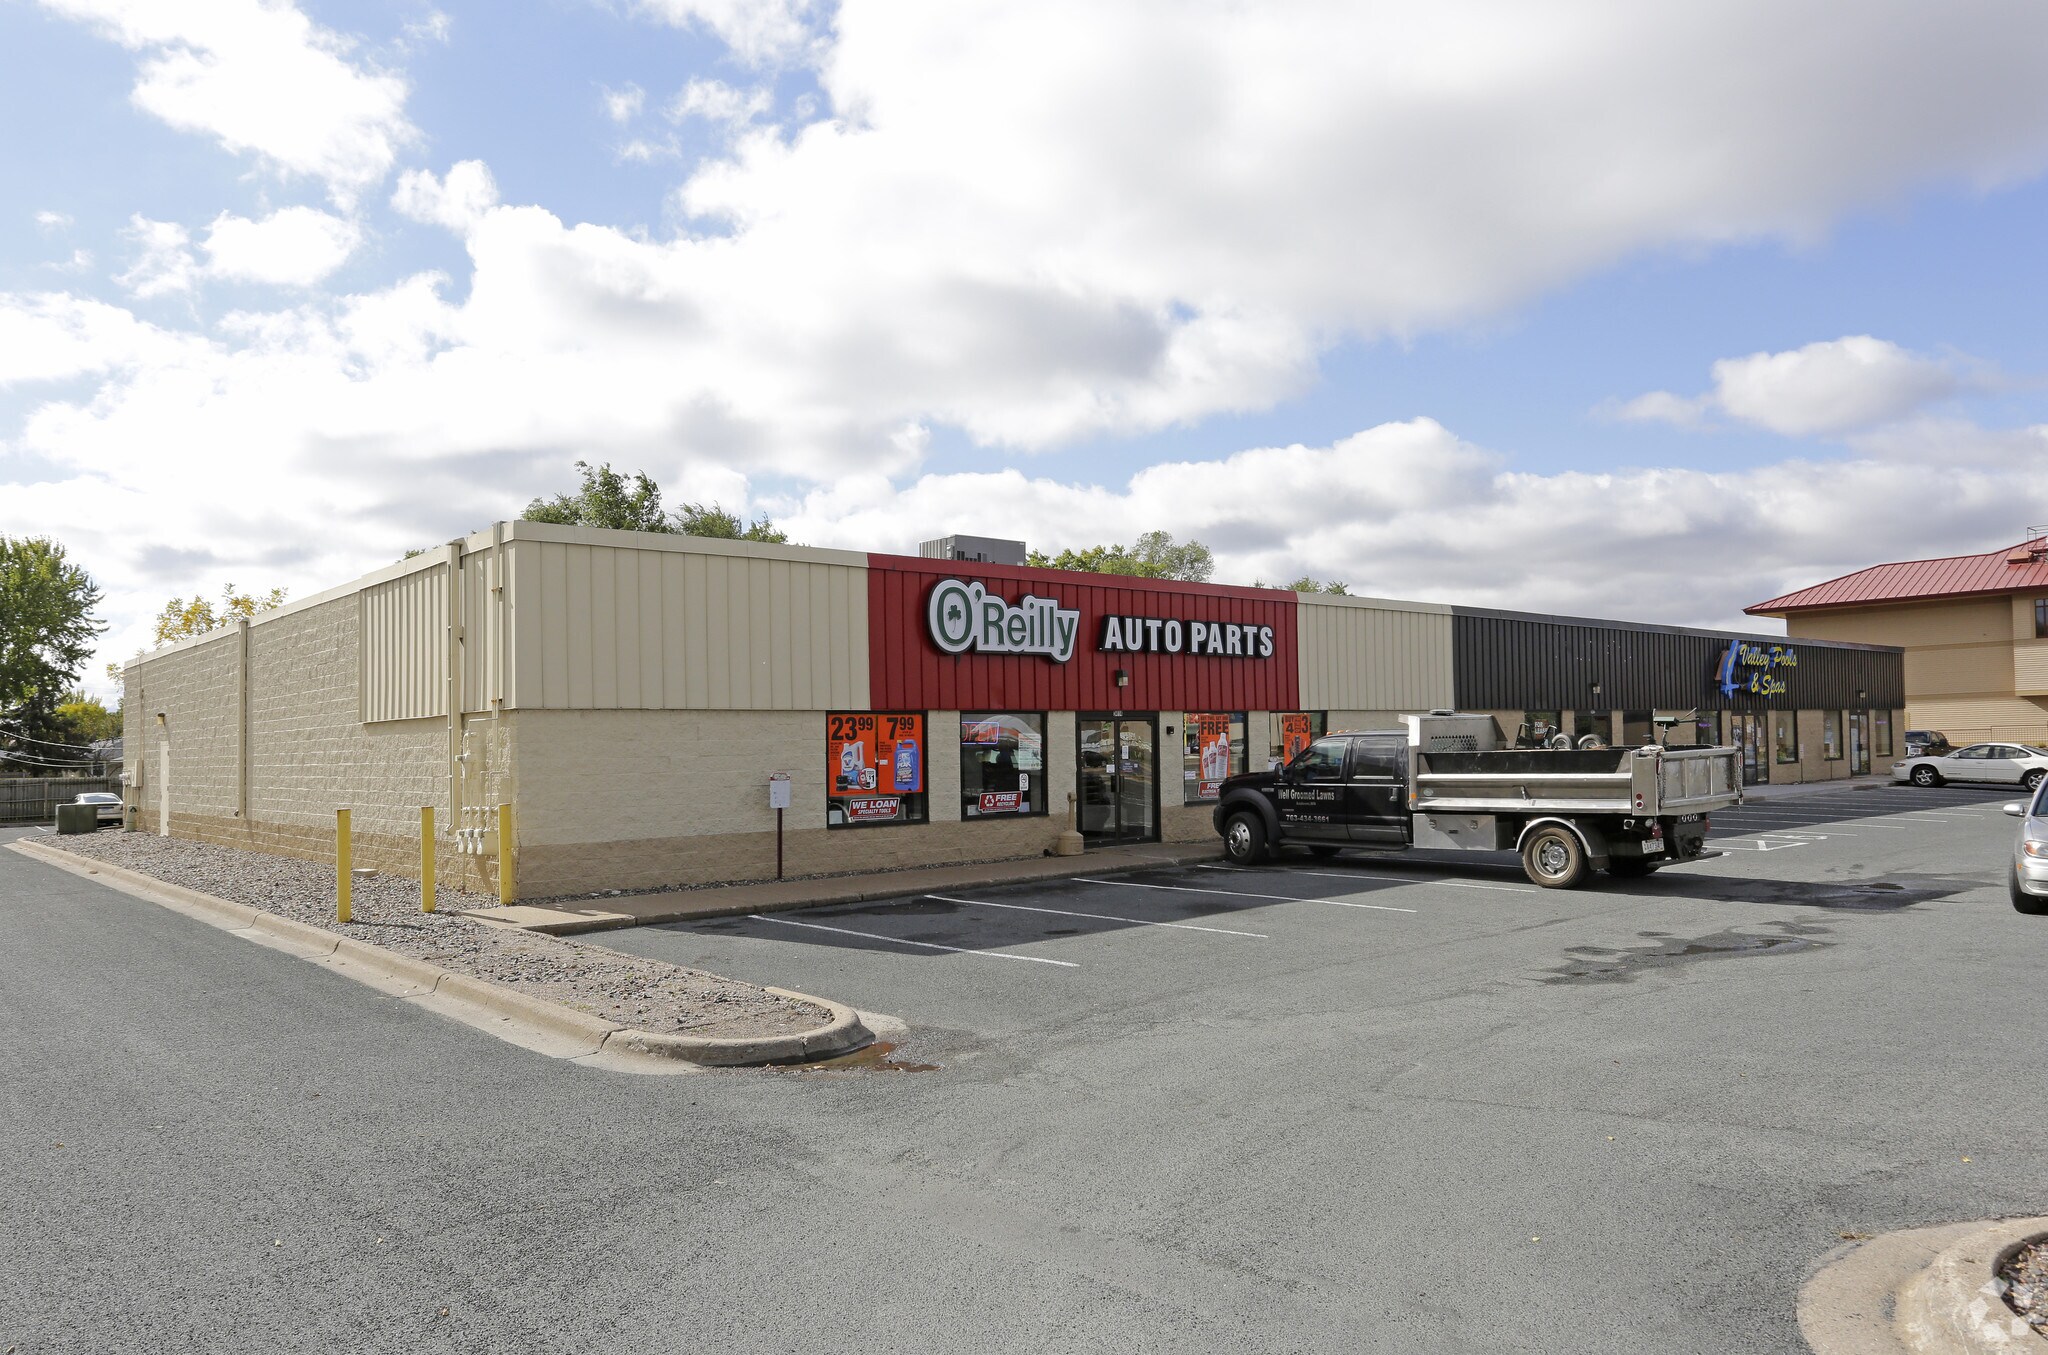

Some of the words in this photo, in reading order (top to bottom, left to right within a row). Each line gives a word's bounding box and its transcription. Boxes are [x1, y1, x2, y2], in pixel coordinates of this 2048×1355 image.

[935, 583, 1076, 657] O'Reilly
[1104, 615, 1182, 652] AUTO
[1190, 621, 1275, 658] PARTS
[1739, 644, 1770, 671] Valley
[1772, 646, 1797, 668] Pools
[1751, 672, 1759, 693] &
[1761, 674, 1786, 699] Spas
[1201, 721, 1229, 735] FREE
[1286, 722, 1294, 733] 4
[1301, 715, 1309, 733] 3
[852, 801, 868, 809] WE
[870, 799, 897, 809] LOAN
[1278, 788, 1290, 800] Well
[1290, 789, 1315, 800] Groomed
[1316, 790, 1335, 801] Lawns
